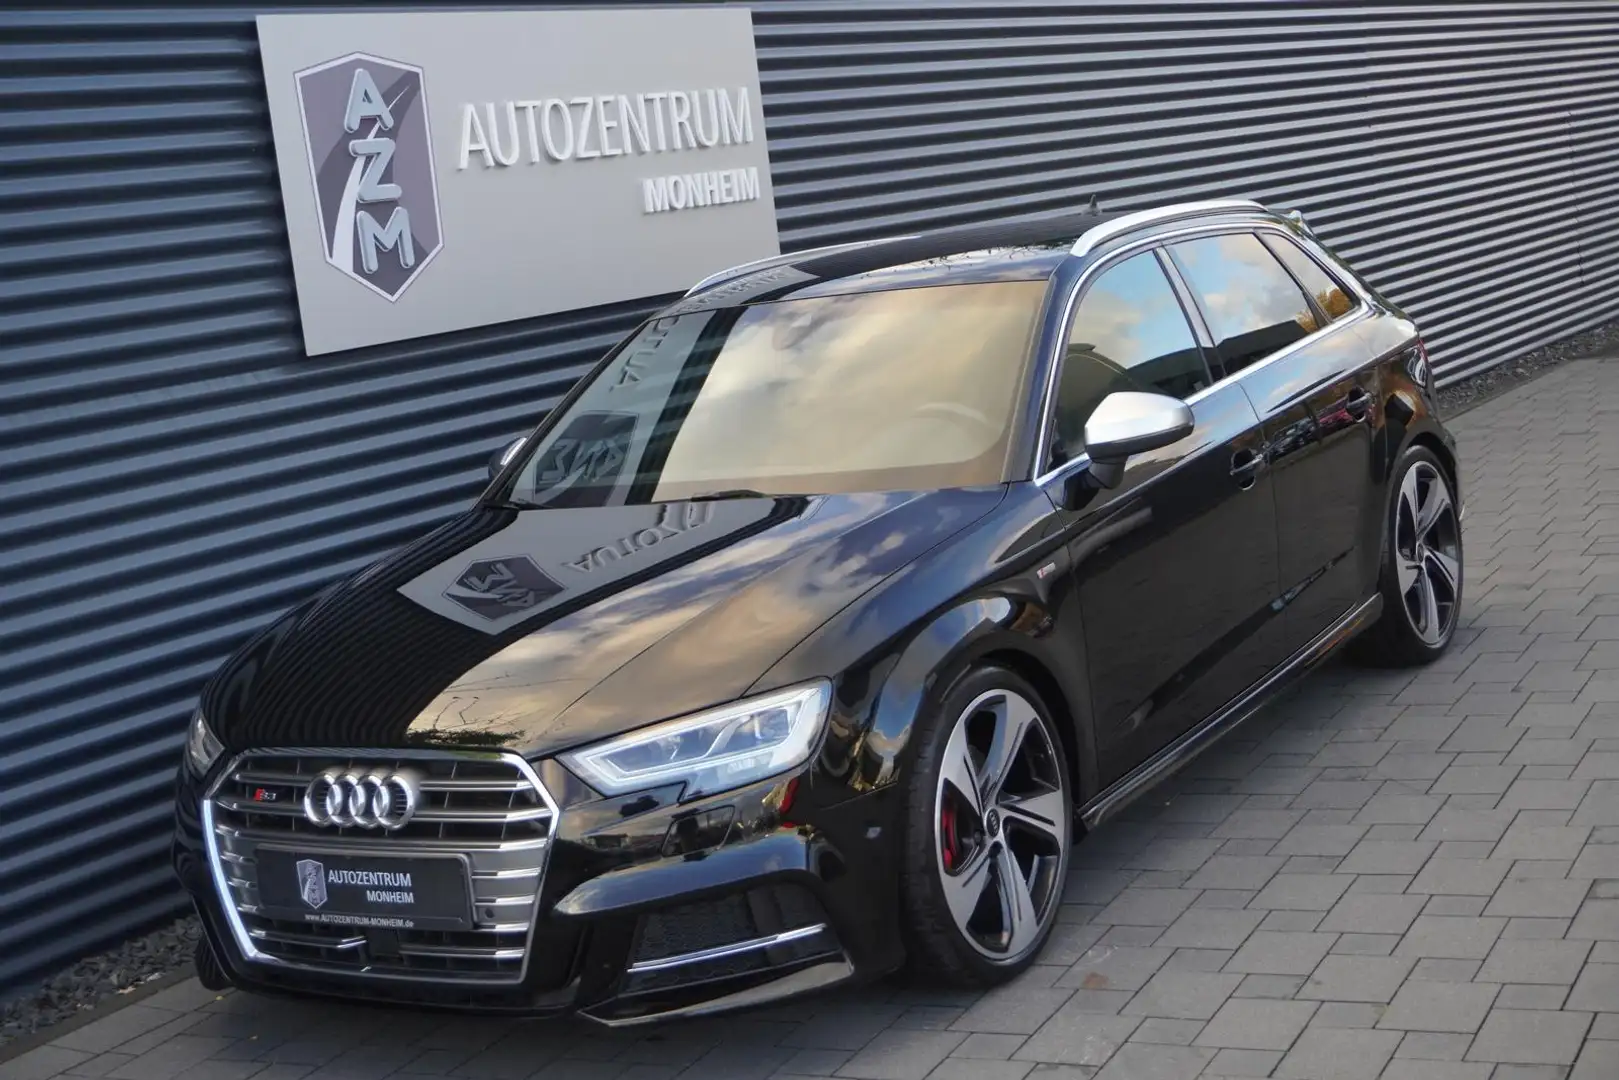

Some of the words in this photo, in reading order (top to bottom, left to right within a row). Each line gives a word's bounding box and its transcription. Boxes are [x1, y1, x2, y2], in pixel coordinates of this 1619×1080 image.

[457, 86, 754, 171] AUTOZENTRUM
[343, 67, 416, 275] AZM
[642, 166, 761, 215] MONHEIM
[328, 869, 412, 887] AUTOZENTRUM
[366, 890, 414, 903] MONHEIM
[304, 913, 414, 928] www.AUTOZENTRUM-MONHEIM.de
